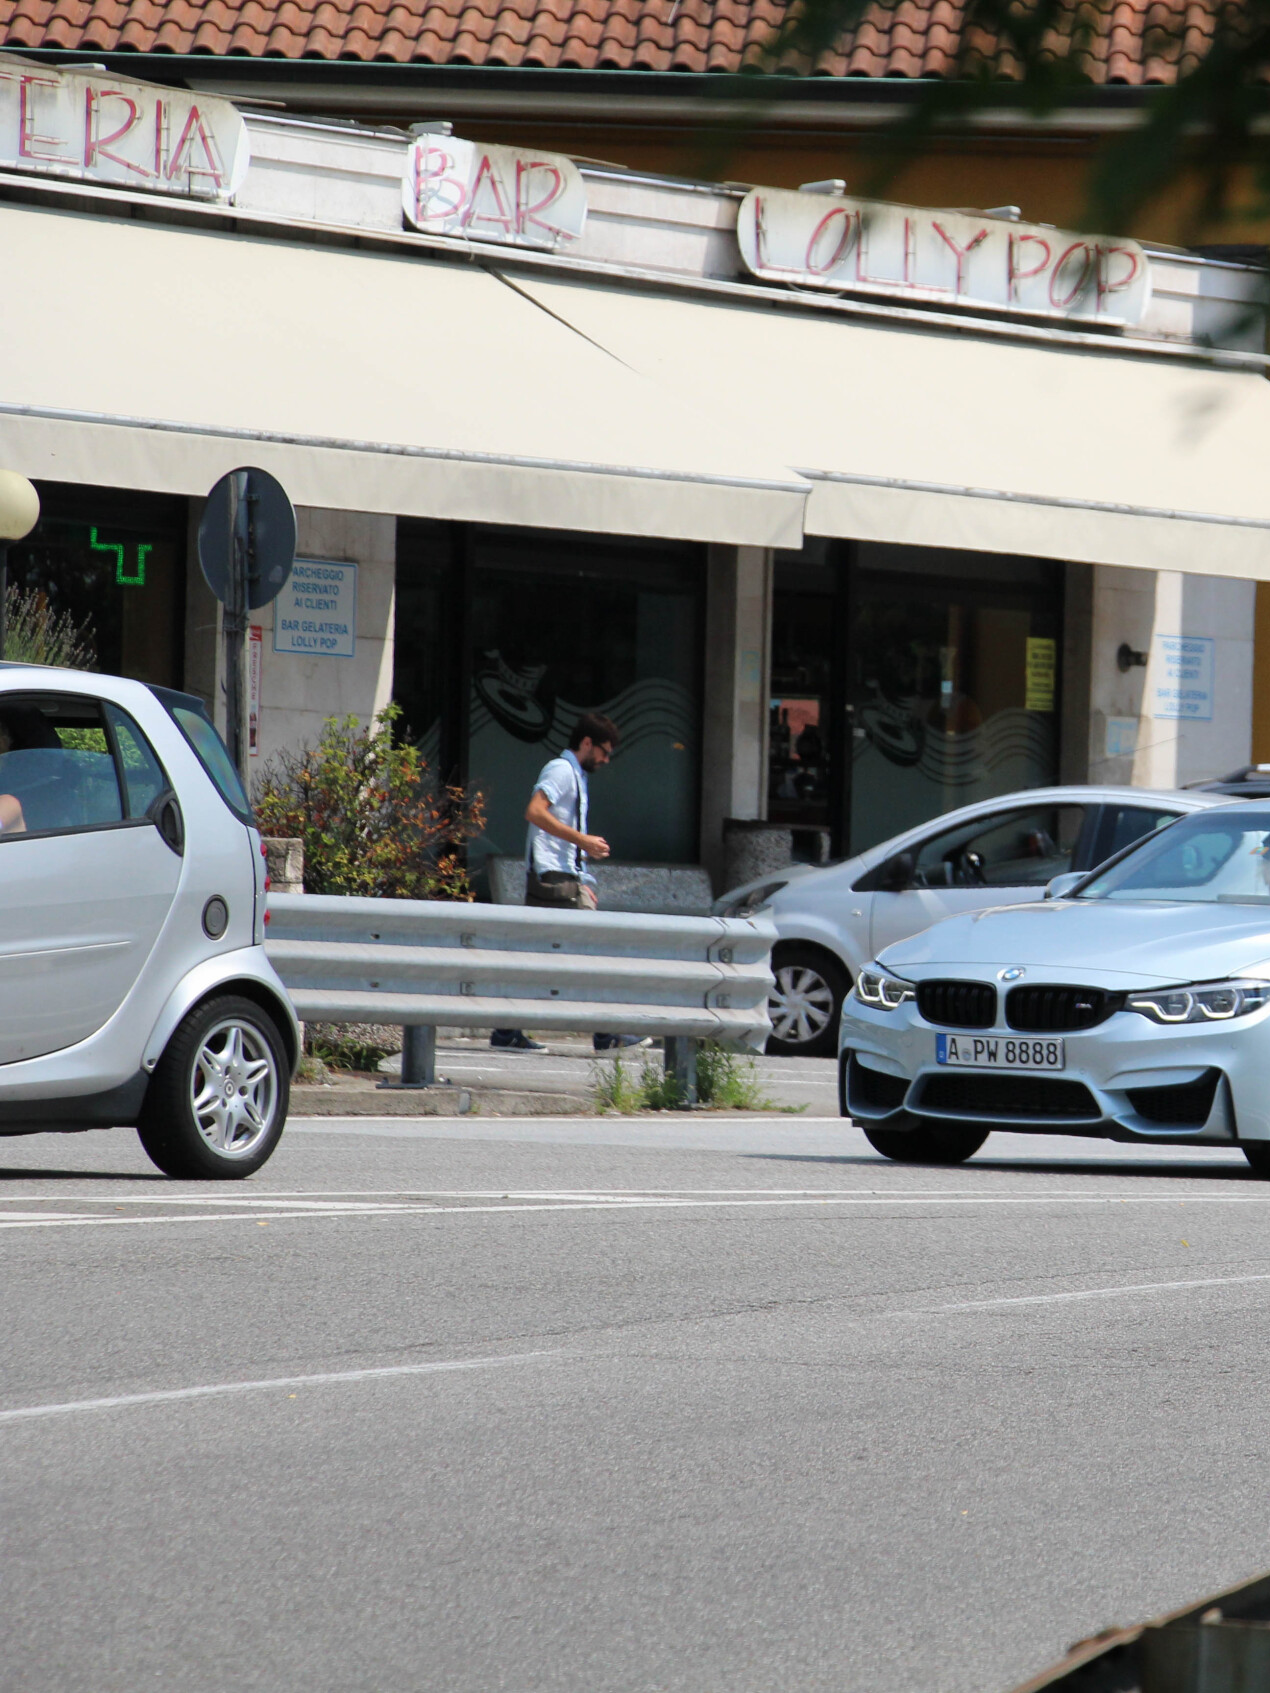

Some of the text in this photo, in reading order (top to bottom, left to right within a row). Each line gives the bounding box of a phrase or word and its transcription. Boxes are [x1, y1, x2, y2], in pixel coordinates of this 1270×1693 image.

[415, 145, 575, 240] BAR
[292, 566, 344, 581] ARCHEGGIO
[292, 581, 339, 596] RISERVATO
[294, 597, 338, 611] AI CLIENTI
[281, 619, 349, 635] BAR GELATERIA
[291, 635, 338, 649] LOLLY POP
[973, 1038, 998, 1063] PW
[1005, 1040, 1058, 1065] 8888
